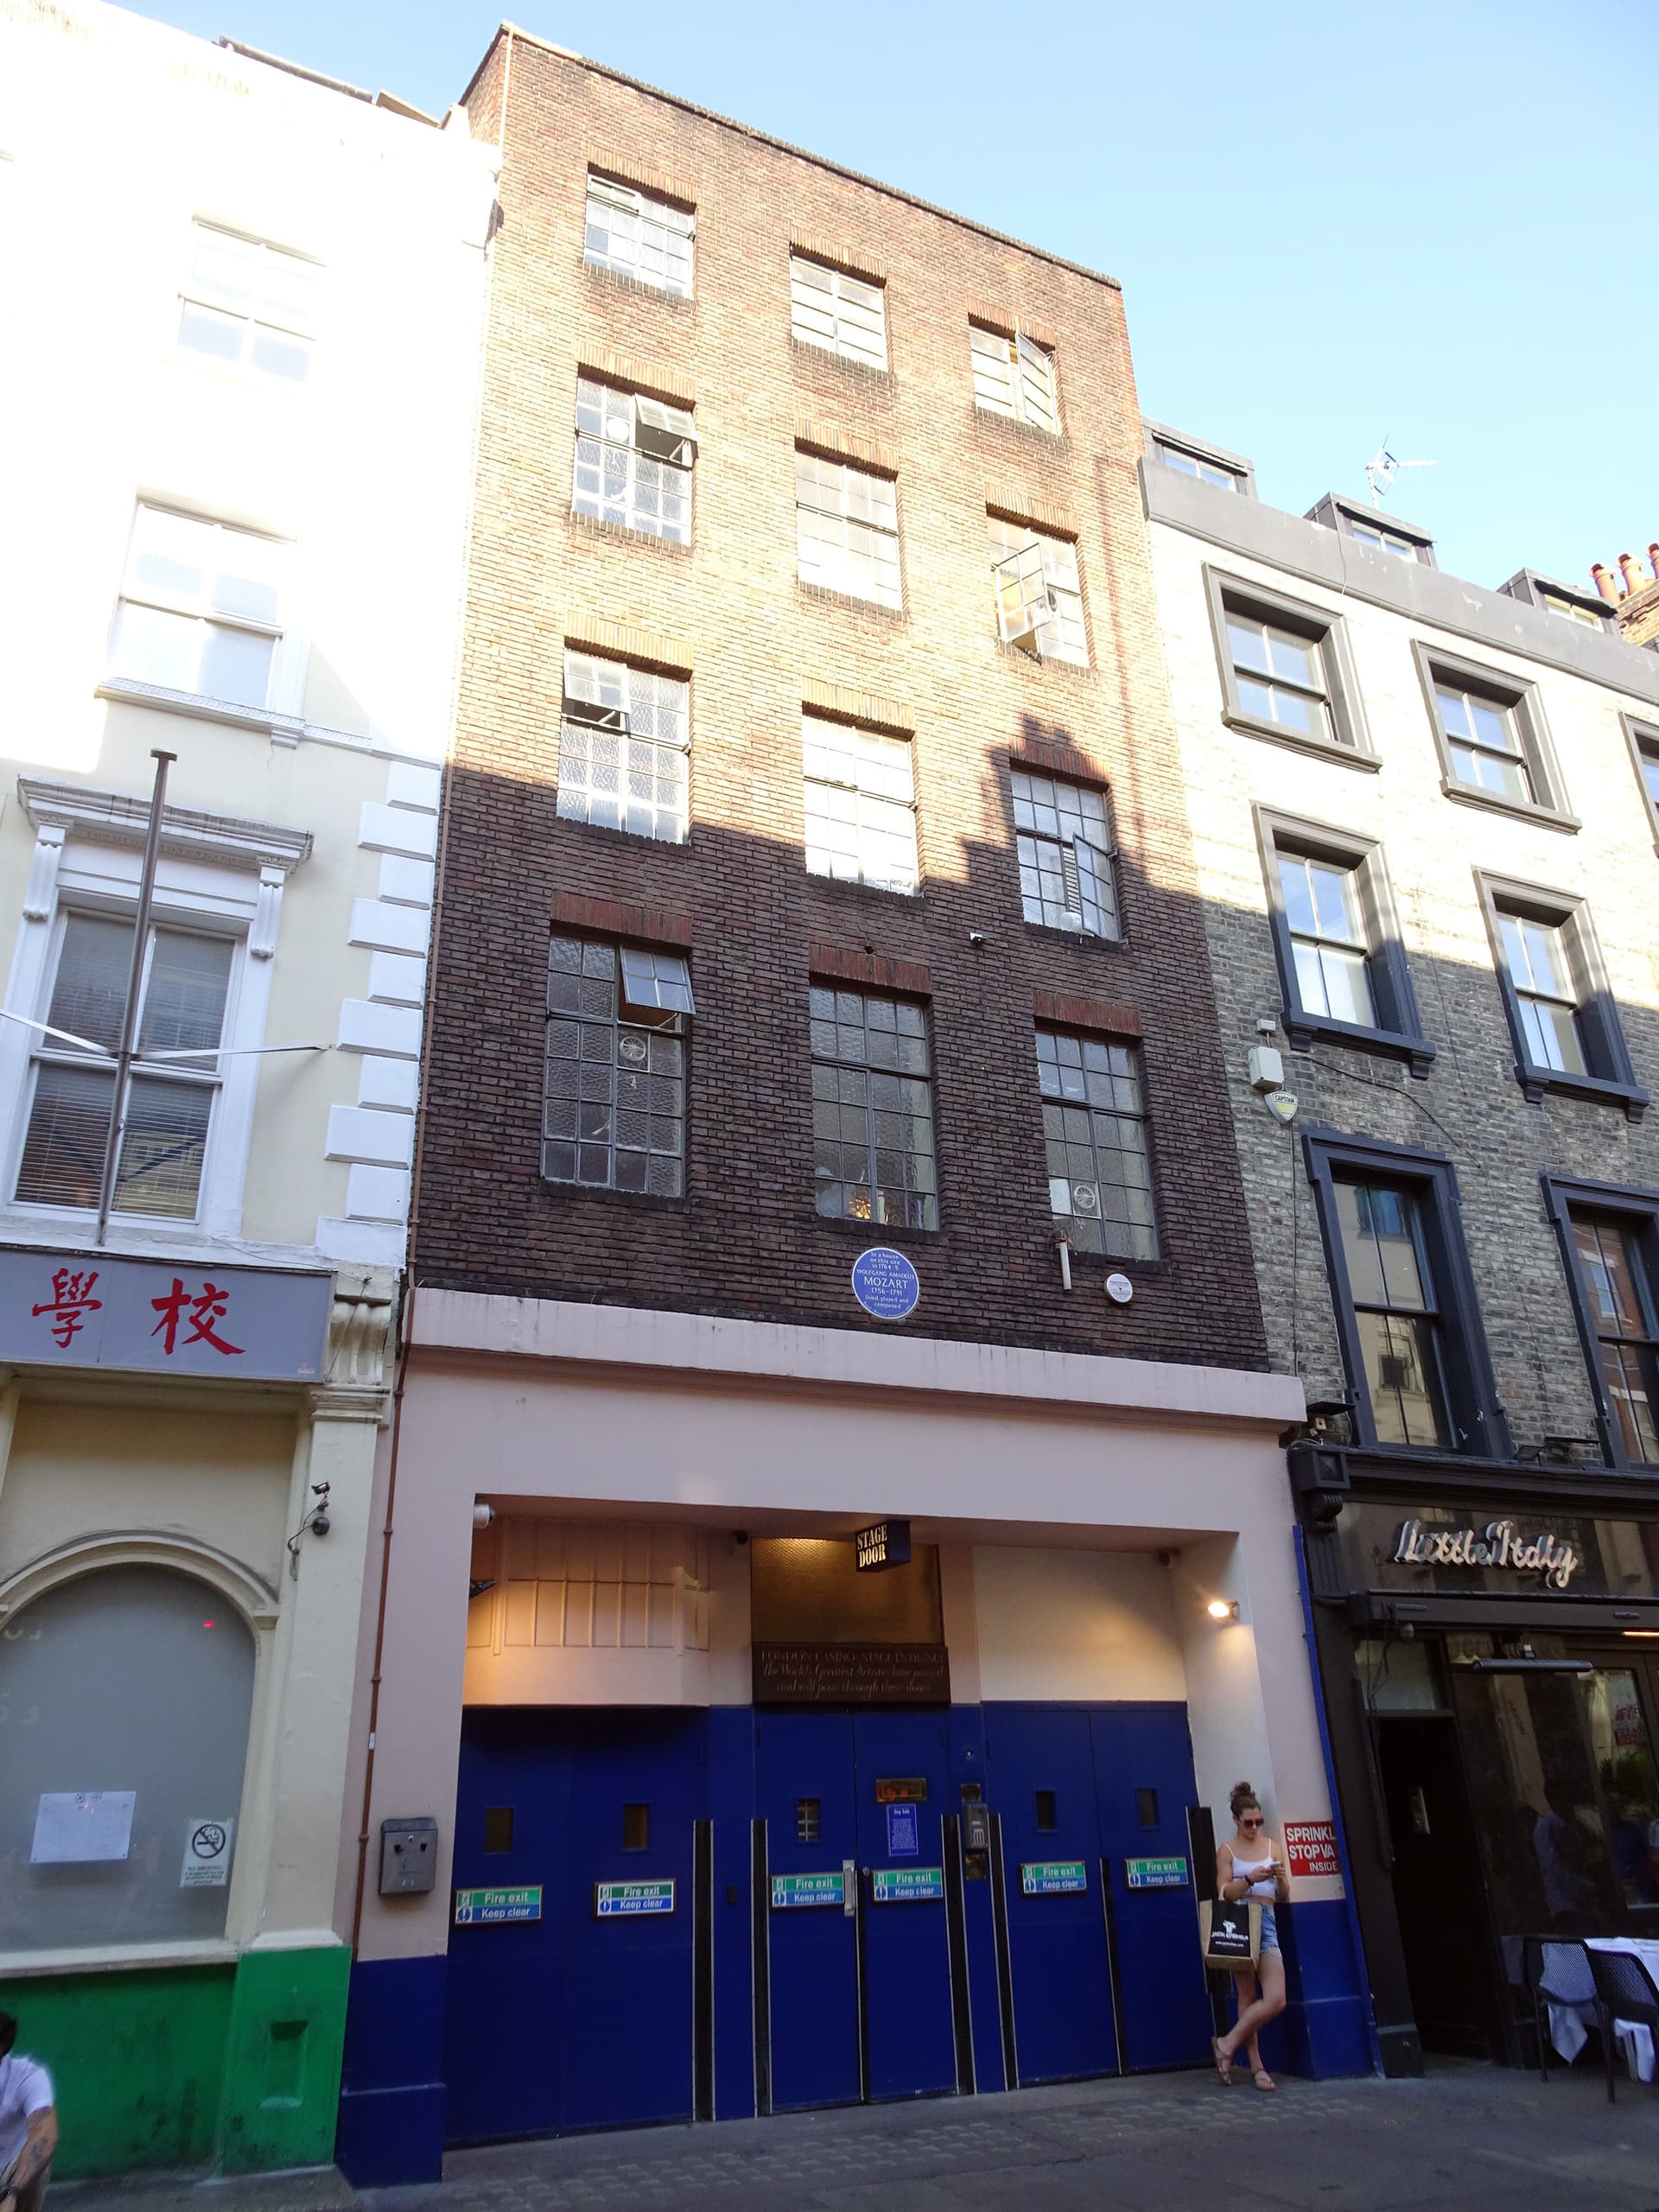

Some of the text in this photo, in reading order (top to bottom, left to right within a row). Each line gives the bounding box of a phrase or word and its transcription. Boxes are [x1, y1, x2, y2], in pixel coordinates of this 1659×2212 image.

[864, 1276, 908, 1288] MOZART
[32, 1268, 245, 1355] 學校
[857, 1524, 887, 1550] STAGE
[859, 1543, 886, 1567] DOOR
[1393, 1519, 1577, 1590] Little Italy
[761, 1651, 811, 1661] LONDON
[764, 1662, 779, 1675] The
[842, 1680, 878, 1700] through
[1288, 1844, 1320, 1859] STOP
[1043, 1866, 1076, 1877] Fire exit
[1146, 1860, 1178, 1872] Fire exit
[1309, 1860, 1338, 1872] INSIDE
[795, 1877, 832, 1889] Fire exit
[896, 1872, 931, 1885] Fire exit
[1042, 1879, 1078, 1890] Keep clear
[1146, 1873, 1180, 1884] Keep clear
[624, 1885, 659, 1897] Fire exit
[894, 1886, 934, 1897] Keep clear
[484, 1891, 528, 1905] Fire exit
[794, 1891, 836, 1904] Keep clear
[620, 1898, 663, 1910] Keep clear
[481, 1907, 531, 1920] Keep clear
